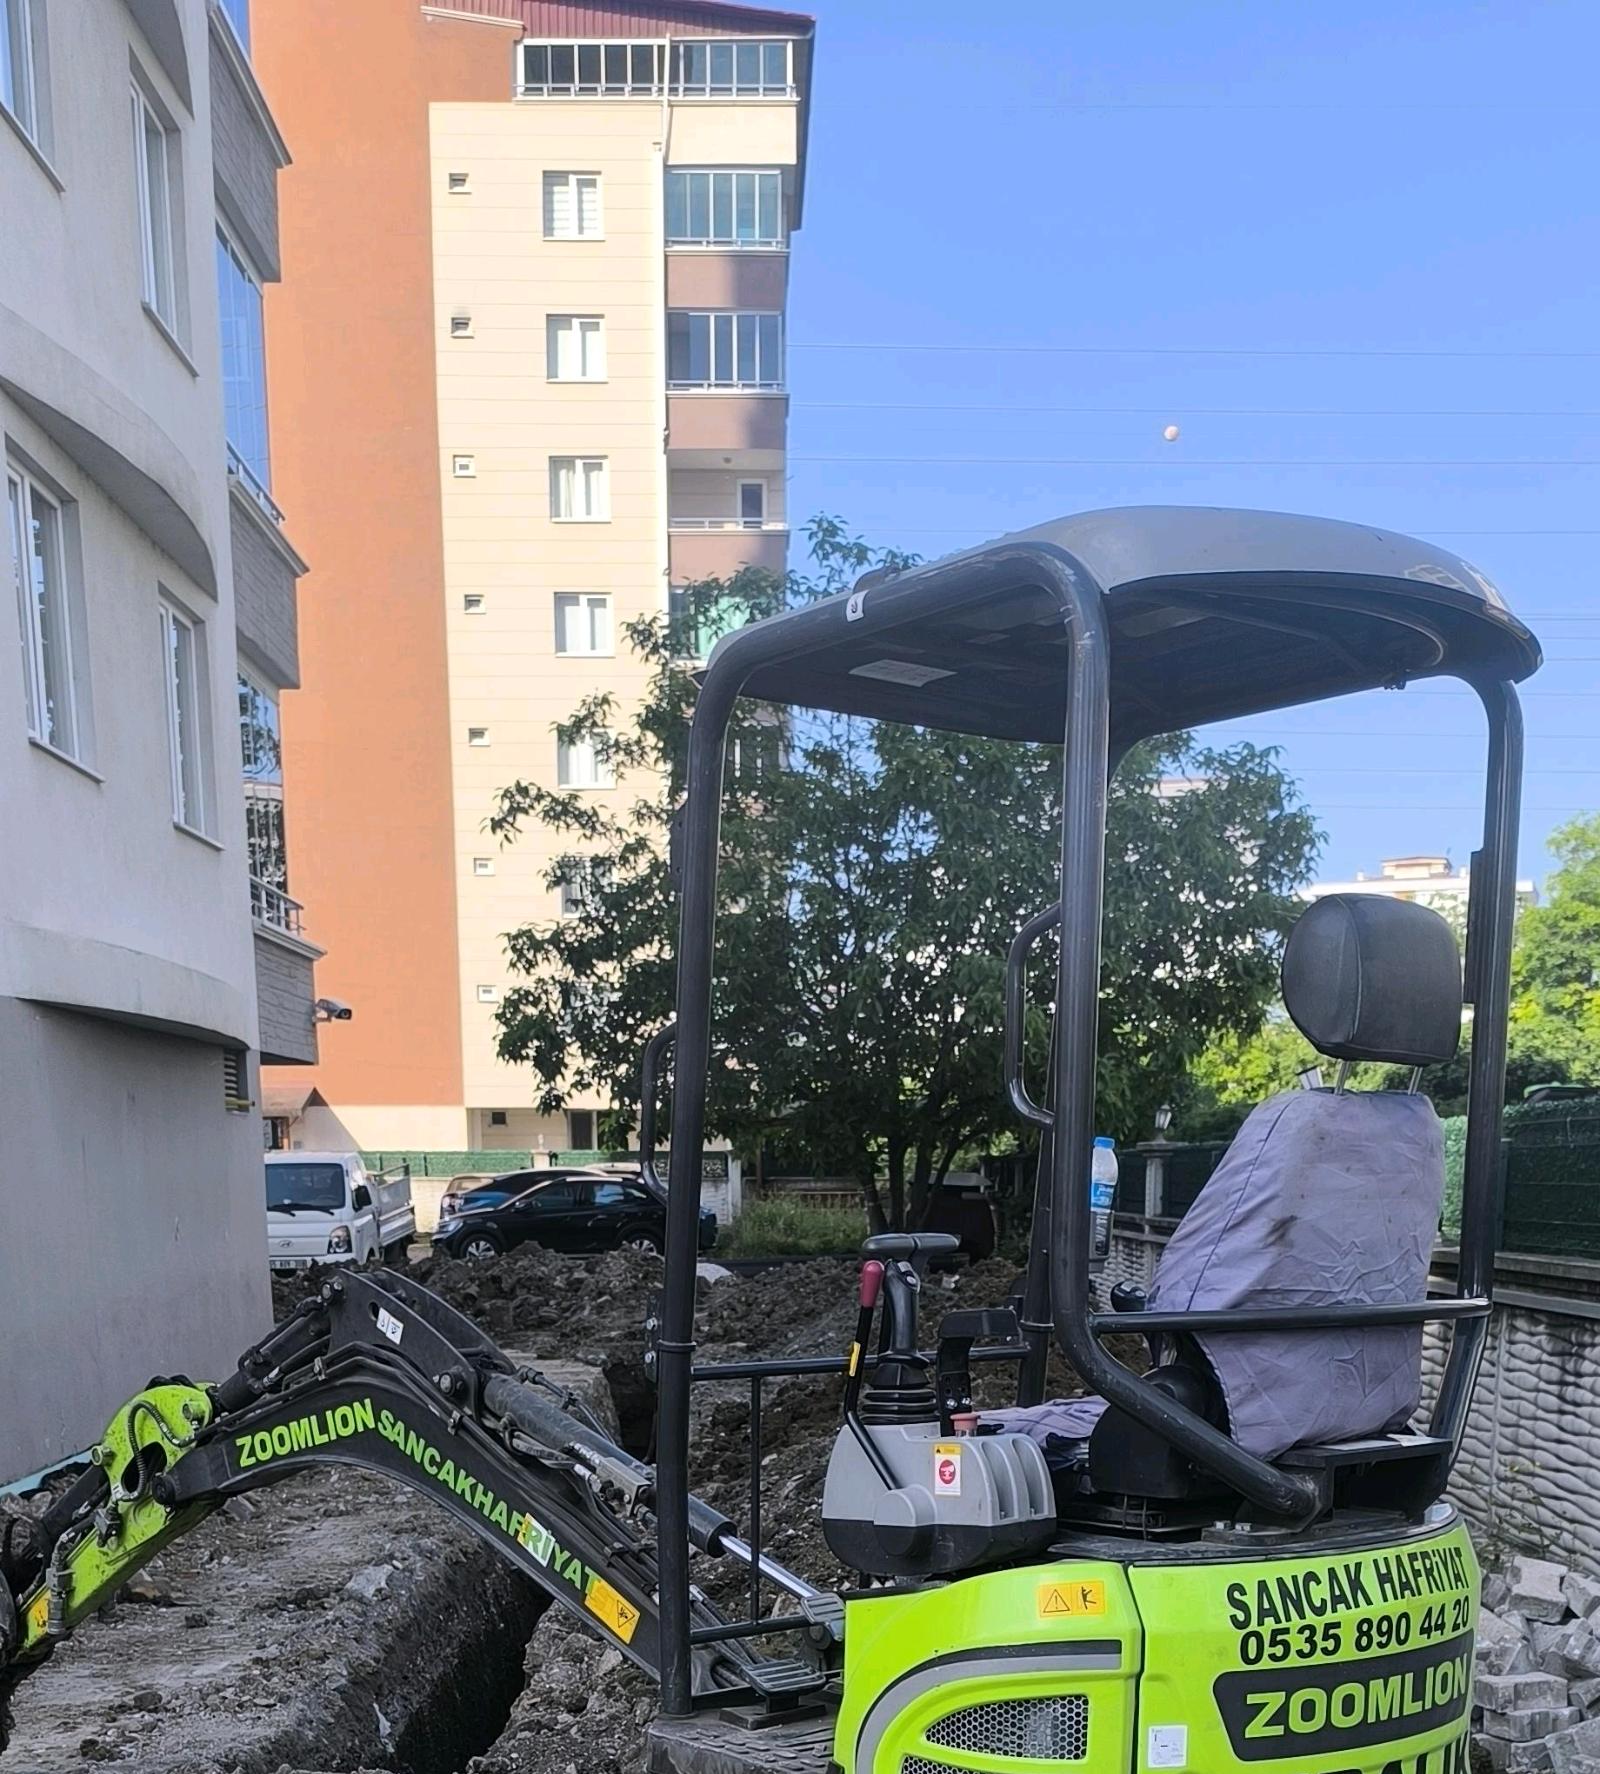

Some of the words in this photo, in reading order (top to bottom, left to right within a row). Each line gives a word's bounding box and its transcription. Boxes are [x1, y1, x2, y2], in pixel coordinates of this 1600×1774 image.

[235, 1398, 375, 1467] ZOOMLION
[1226, 1561, 1373, 1630] SANCAK
[1240, 1622, 1342, 1665] 0535
[1355, 1612, 1410, 1652] 890
[1419, 1603, 1446, 1640] 44
[1452, 1595, 1469, 1633] 20
[1244, 1653, 1468, 1738] ZOOMLION
